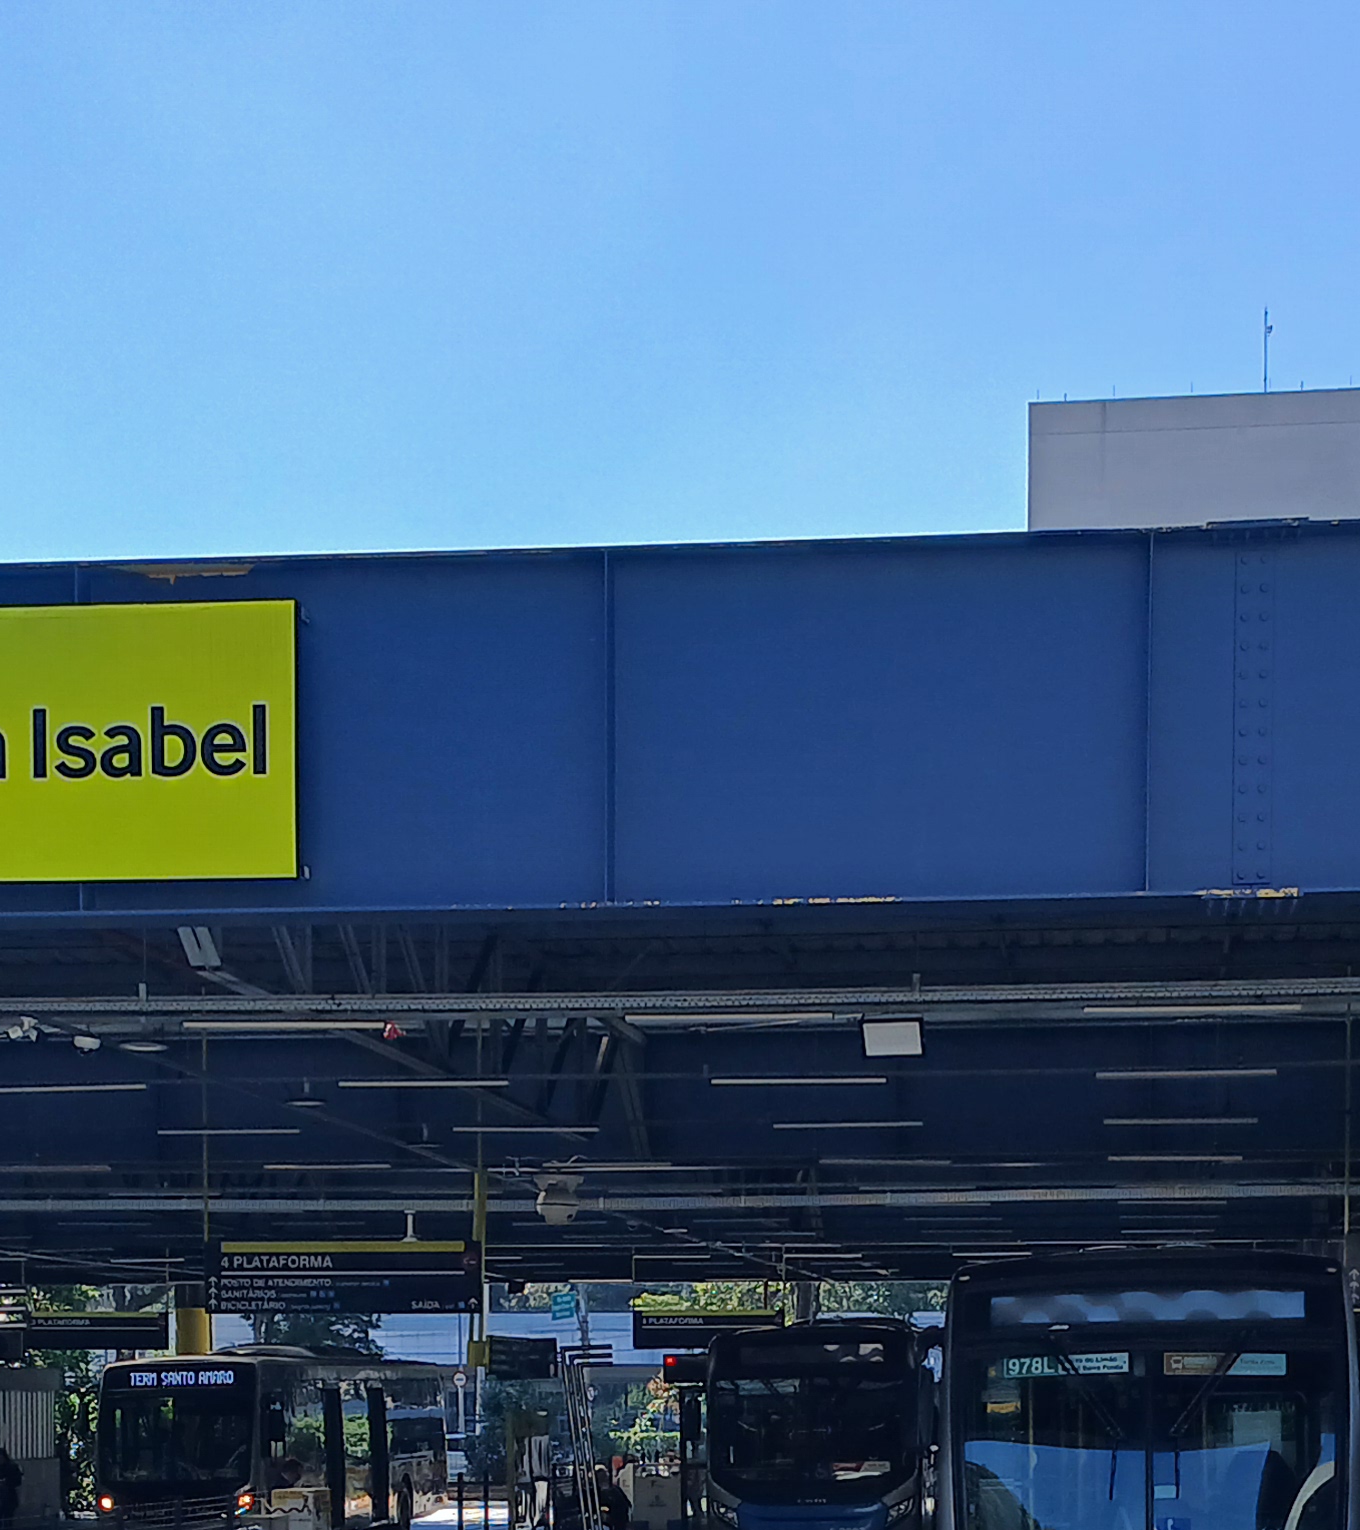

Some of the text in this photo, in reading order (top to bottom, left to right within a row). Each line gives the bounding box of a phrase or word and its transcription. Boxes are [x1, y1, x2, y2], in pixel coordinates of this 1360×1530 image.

[32, 704, 269, 781] Isabel
[221, 1255, 333, 1269] 4 PLATAFORMA
[221, 1278, 251, 1287] POSTO
[253, 1278, 265, 1287] DE
[268, 1278, 332, 1287] ATENDIMENTO
[221, 1288, 277, 1299] SANITÁRIOS
[221, 1298, 286, 1311] BICICLETÁRIO
[411, 1299, 441, 1310] SAÍDA
[1008, 1356, 1056, 1376] 978L
[129, 1370, 235, 1387] TERM SANTO AMARO
